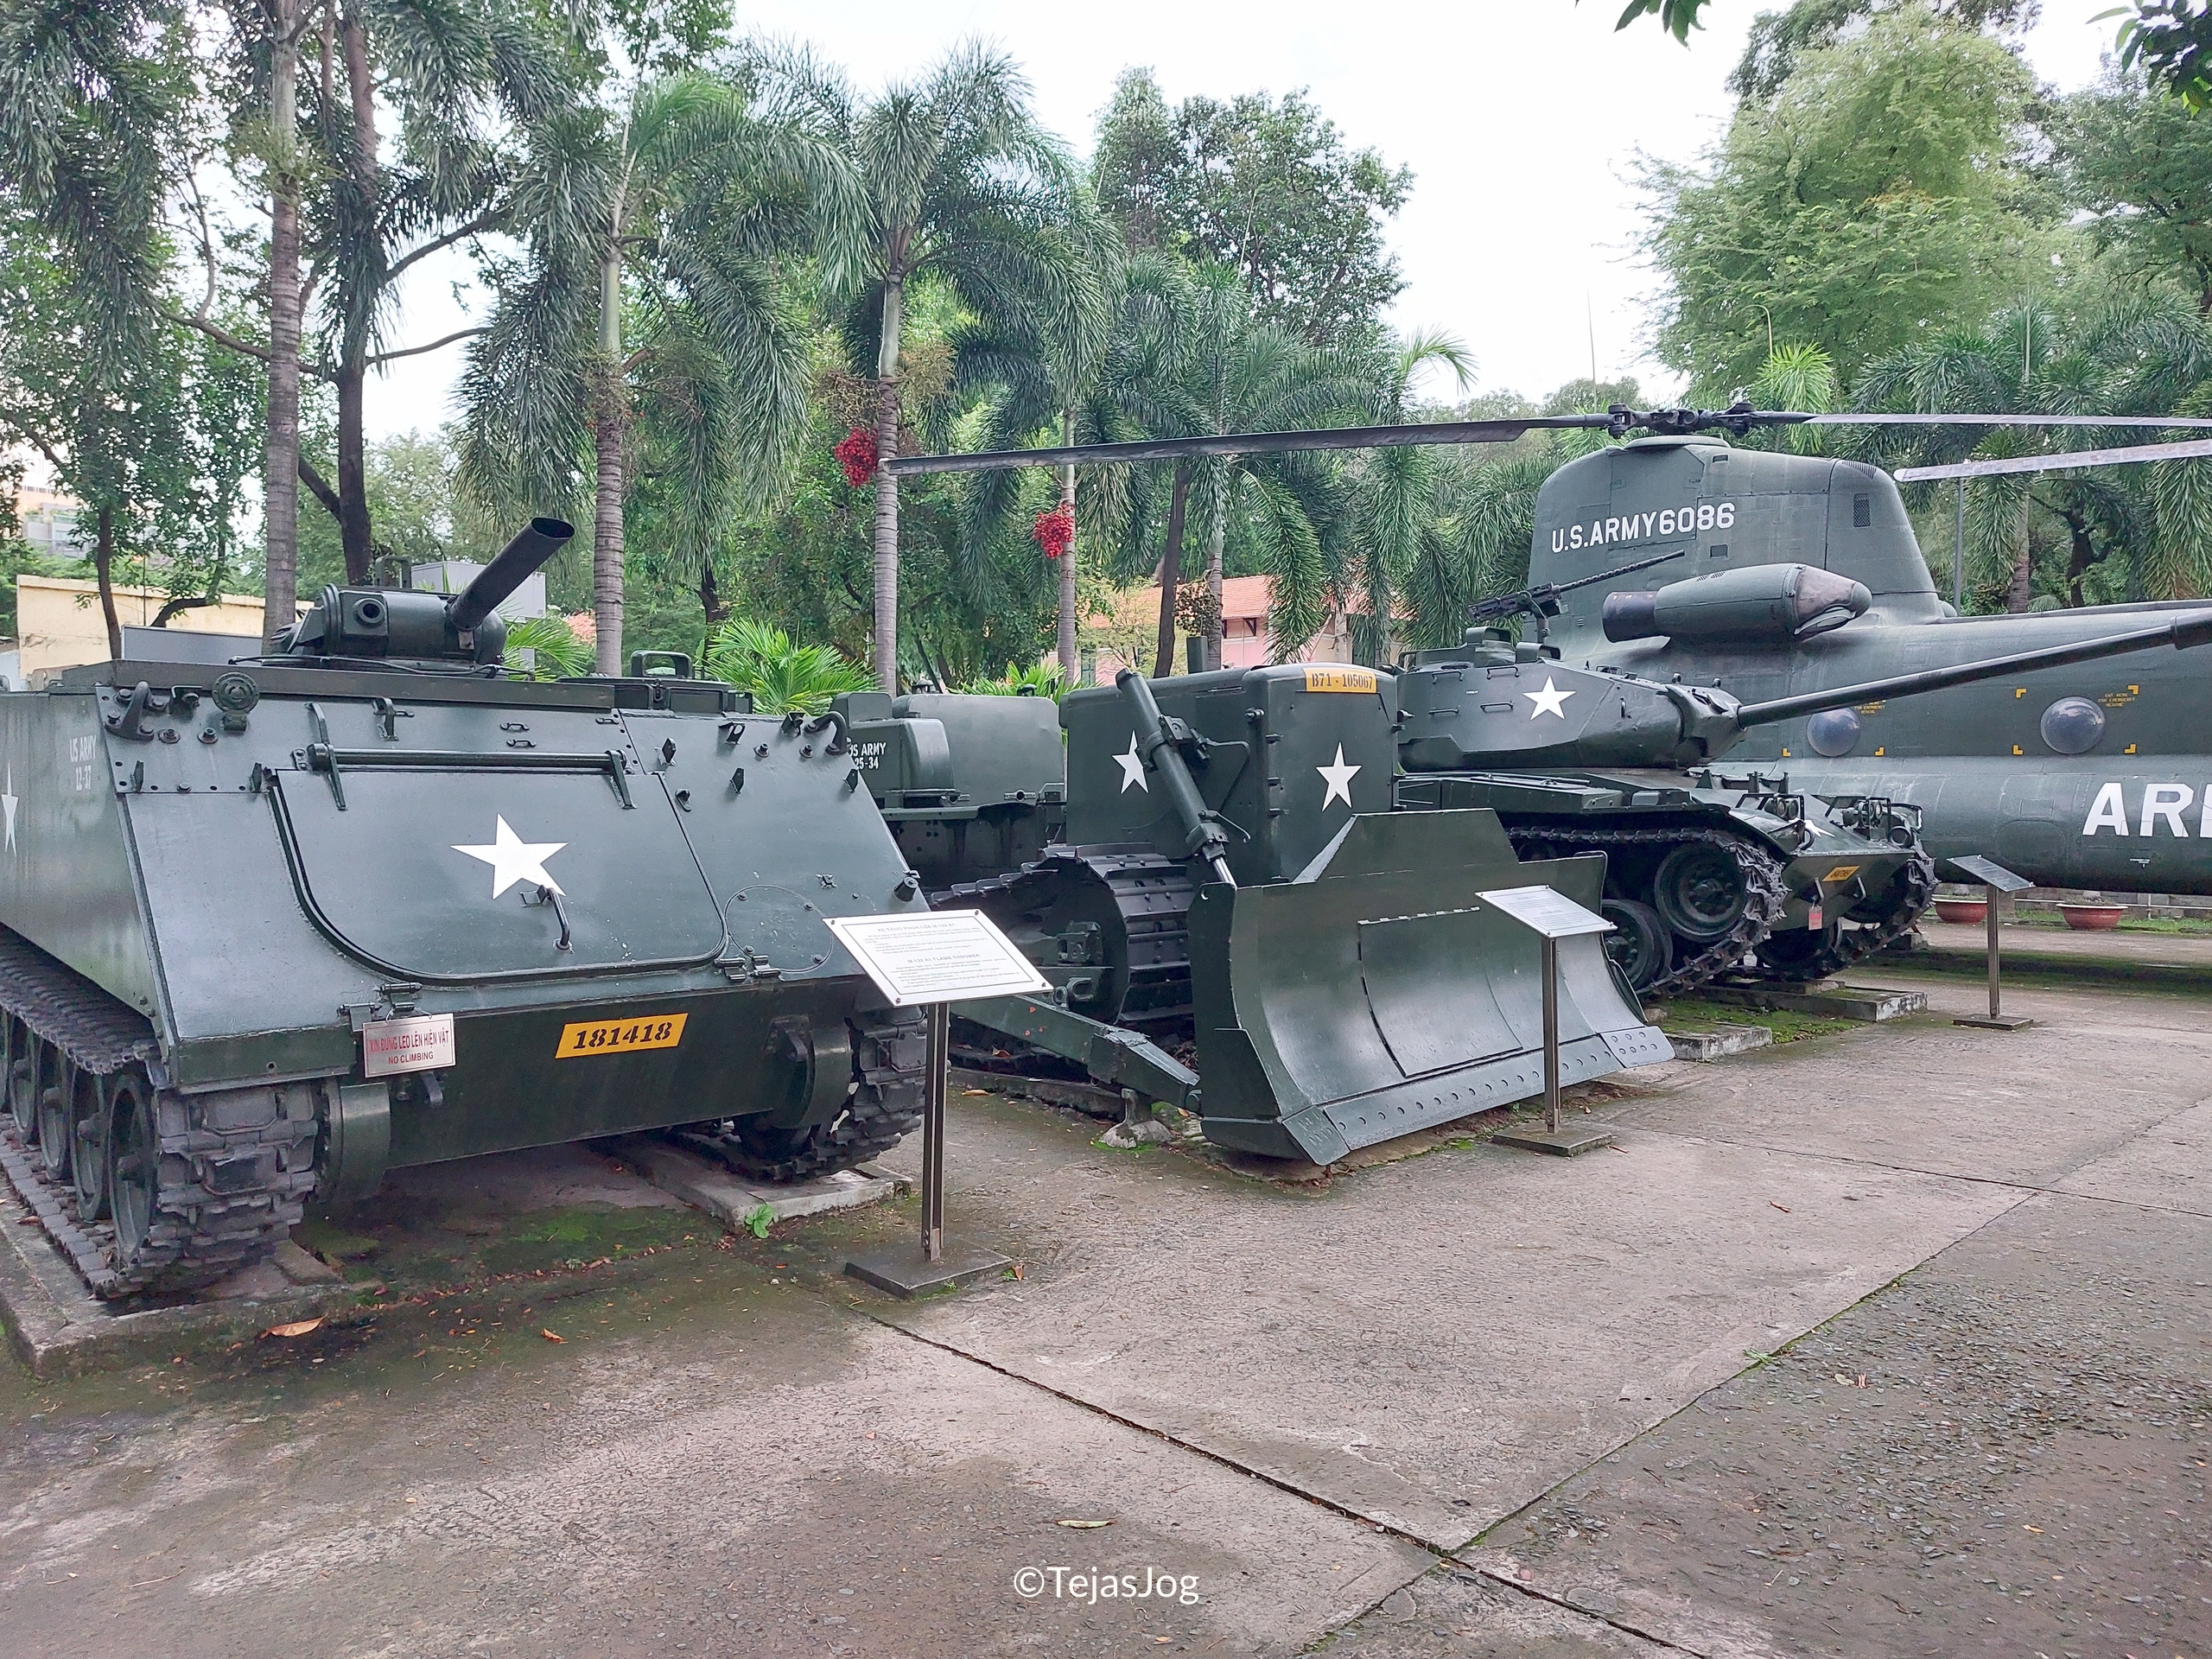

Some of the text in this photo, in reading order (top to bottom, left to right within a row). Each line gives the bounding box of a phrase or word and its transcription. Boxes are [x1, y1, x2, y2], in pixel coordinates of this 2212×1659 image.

[1312, 673, 1332, 687] B71
[70, 734, 96, 762] US ARMY
[861, 742, 887, 756] ARMY
[2082, 782, 2212, 838] AR
[370, 1039, 379, 1052] XIN
[398, 1035, 410, 1049] LEO
[411, 1030, 423, 1047] LÊN
[573, 1022, 672, 1049] 181418
[388, 1051, 434, 1065] NO CLIMBING
